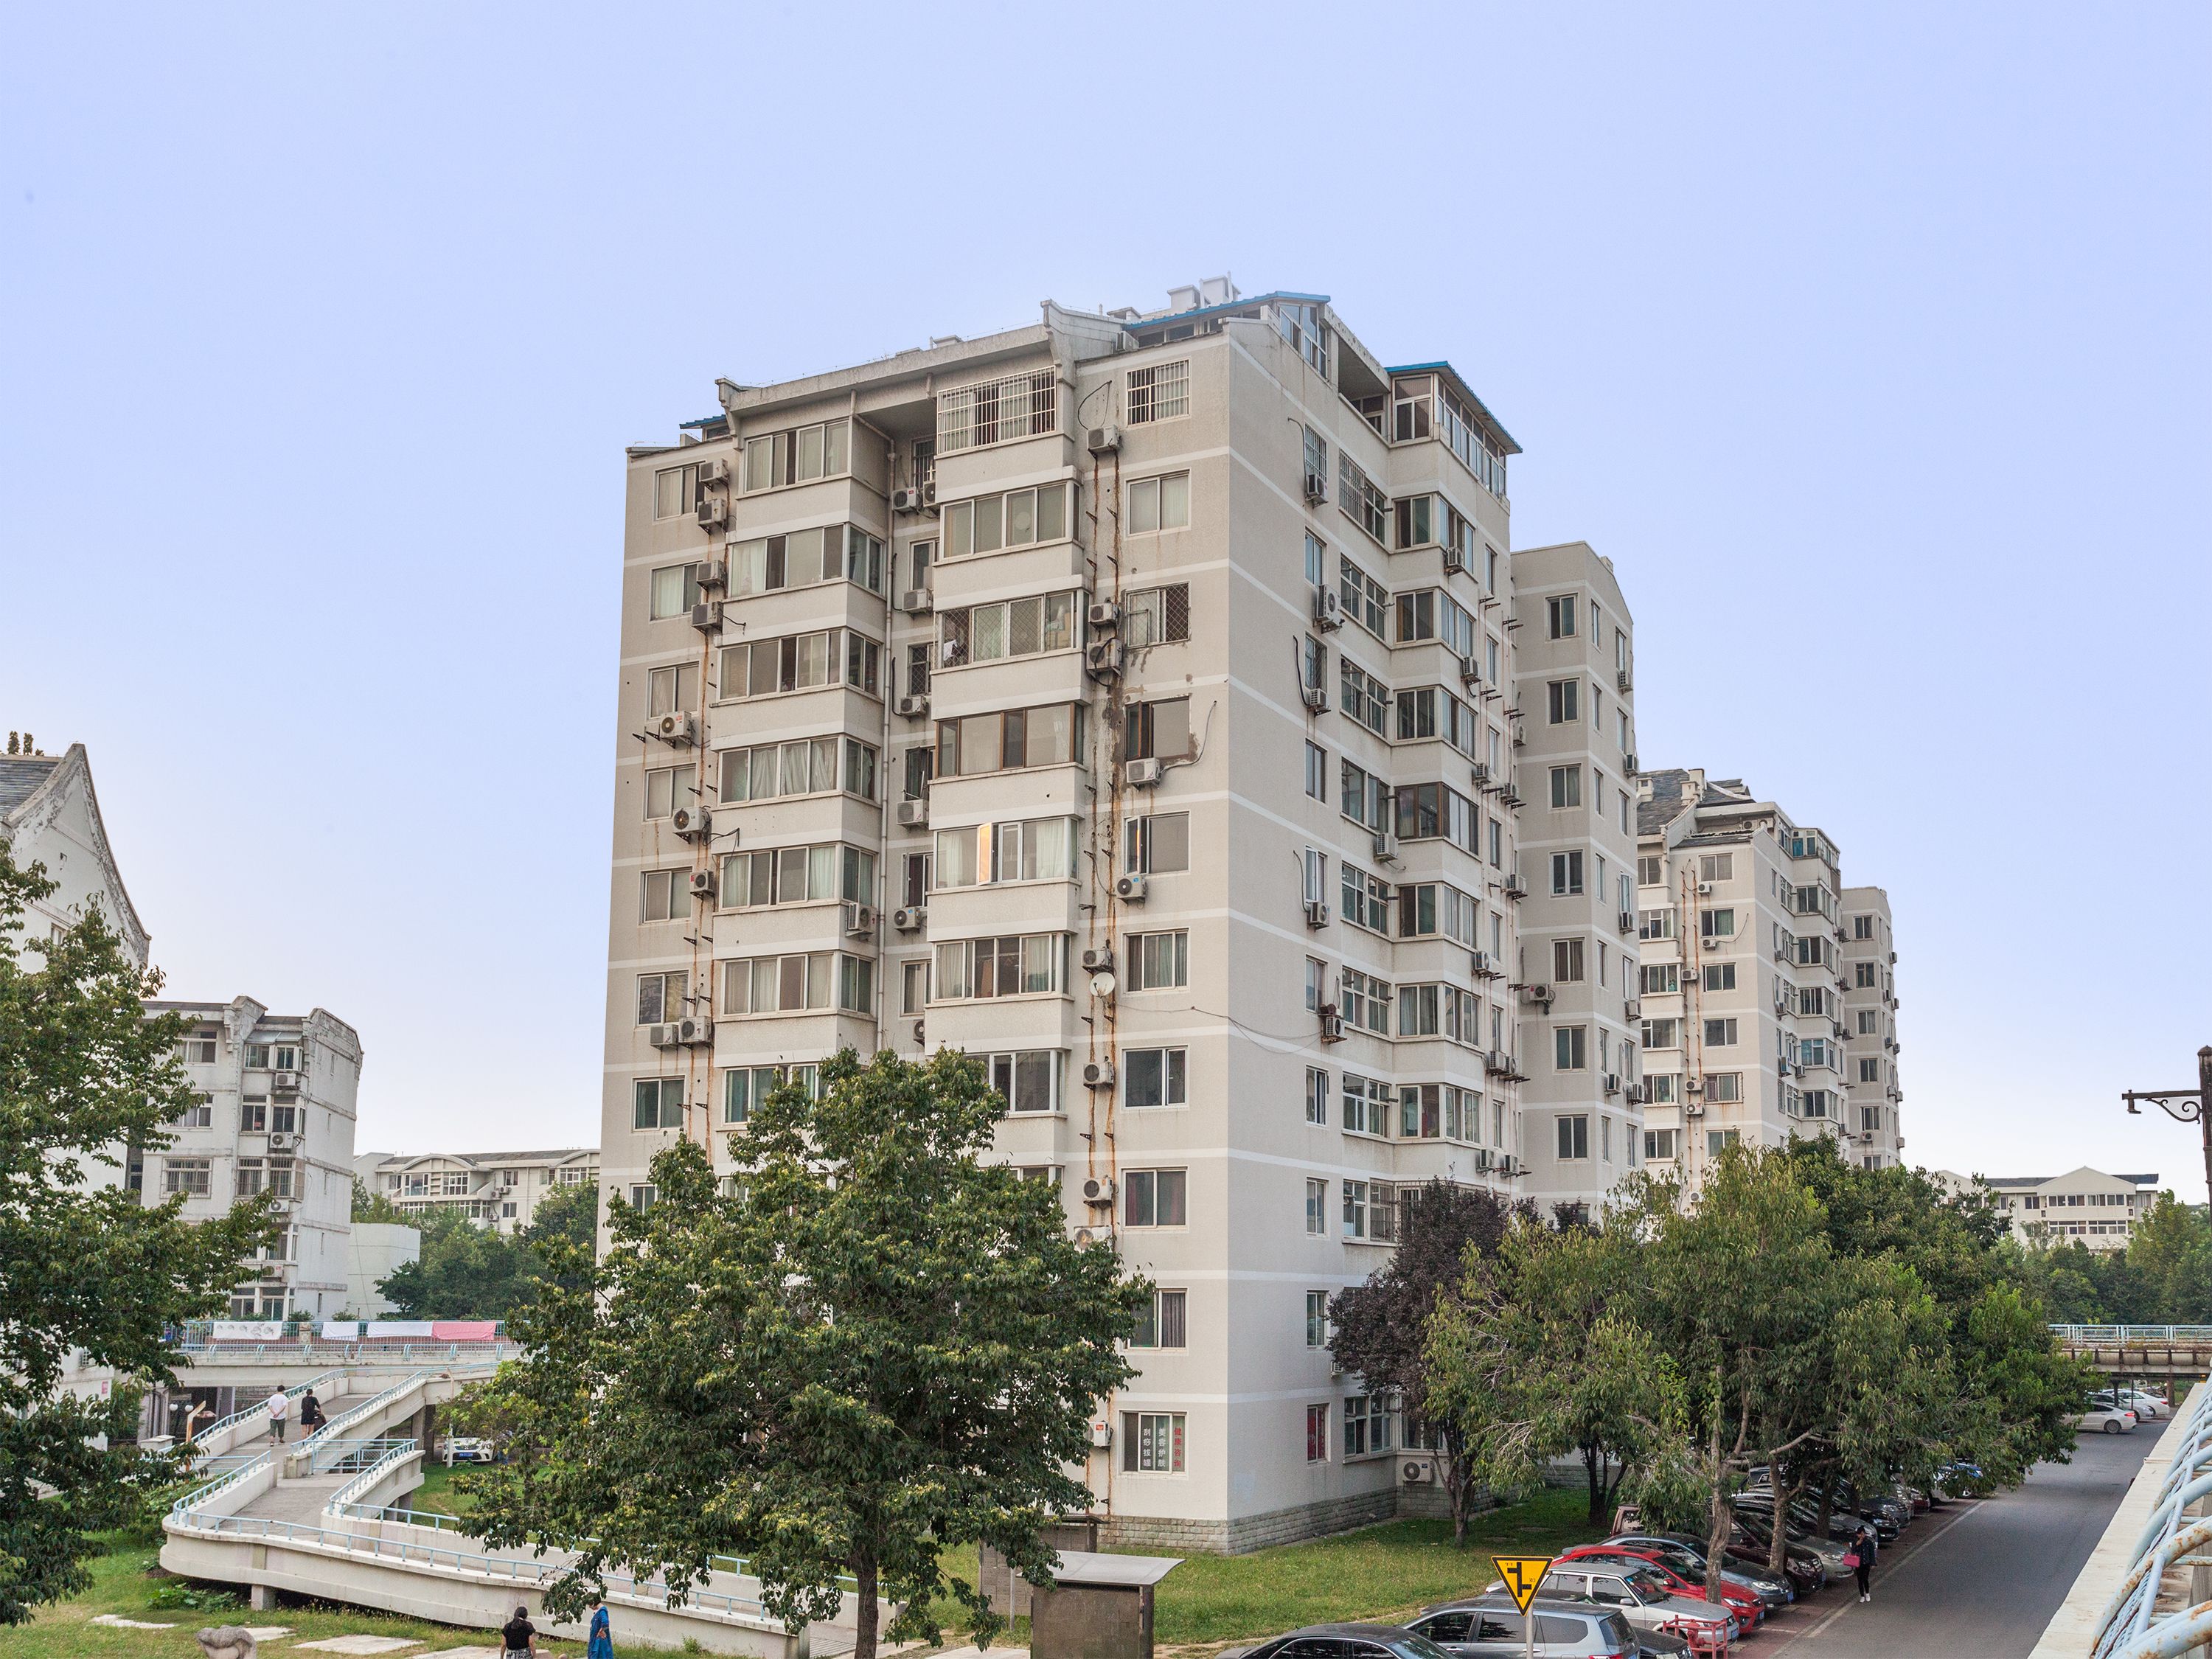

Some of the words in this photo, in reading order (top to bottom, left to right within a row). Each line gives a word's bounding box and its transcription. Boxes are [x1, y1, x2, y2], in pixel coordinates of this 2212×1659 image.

[1143, 1427, 1152, 1467] 刮痧拔罐
[1158, 1427, 1166, 1467] 美容护肤
[1174, 1427, 1182, 1467] 健康咨询
